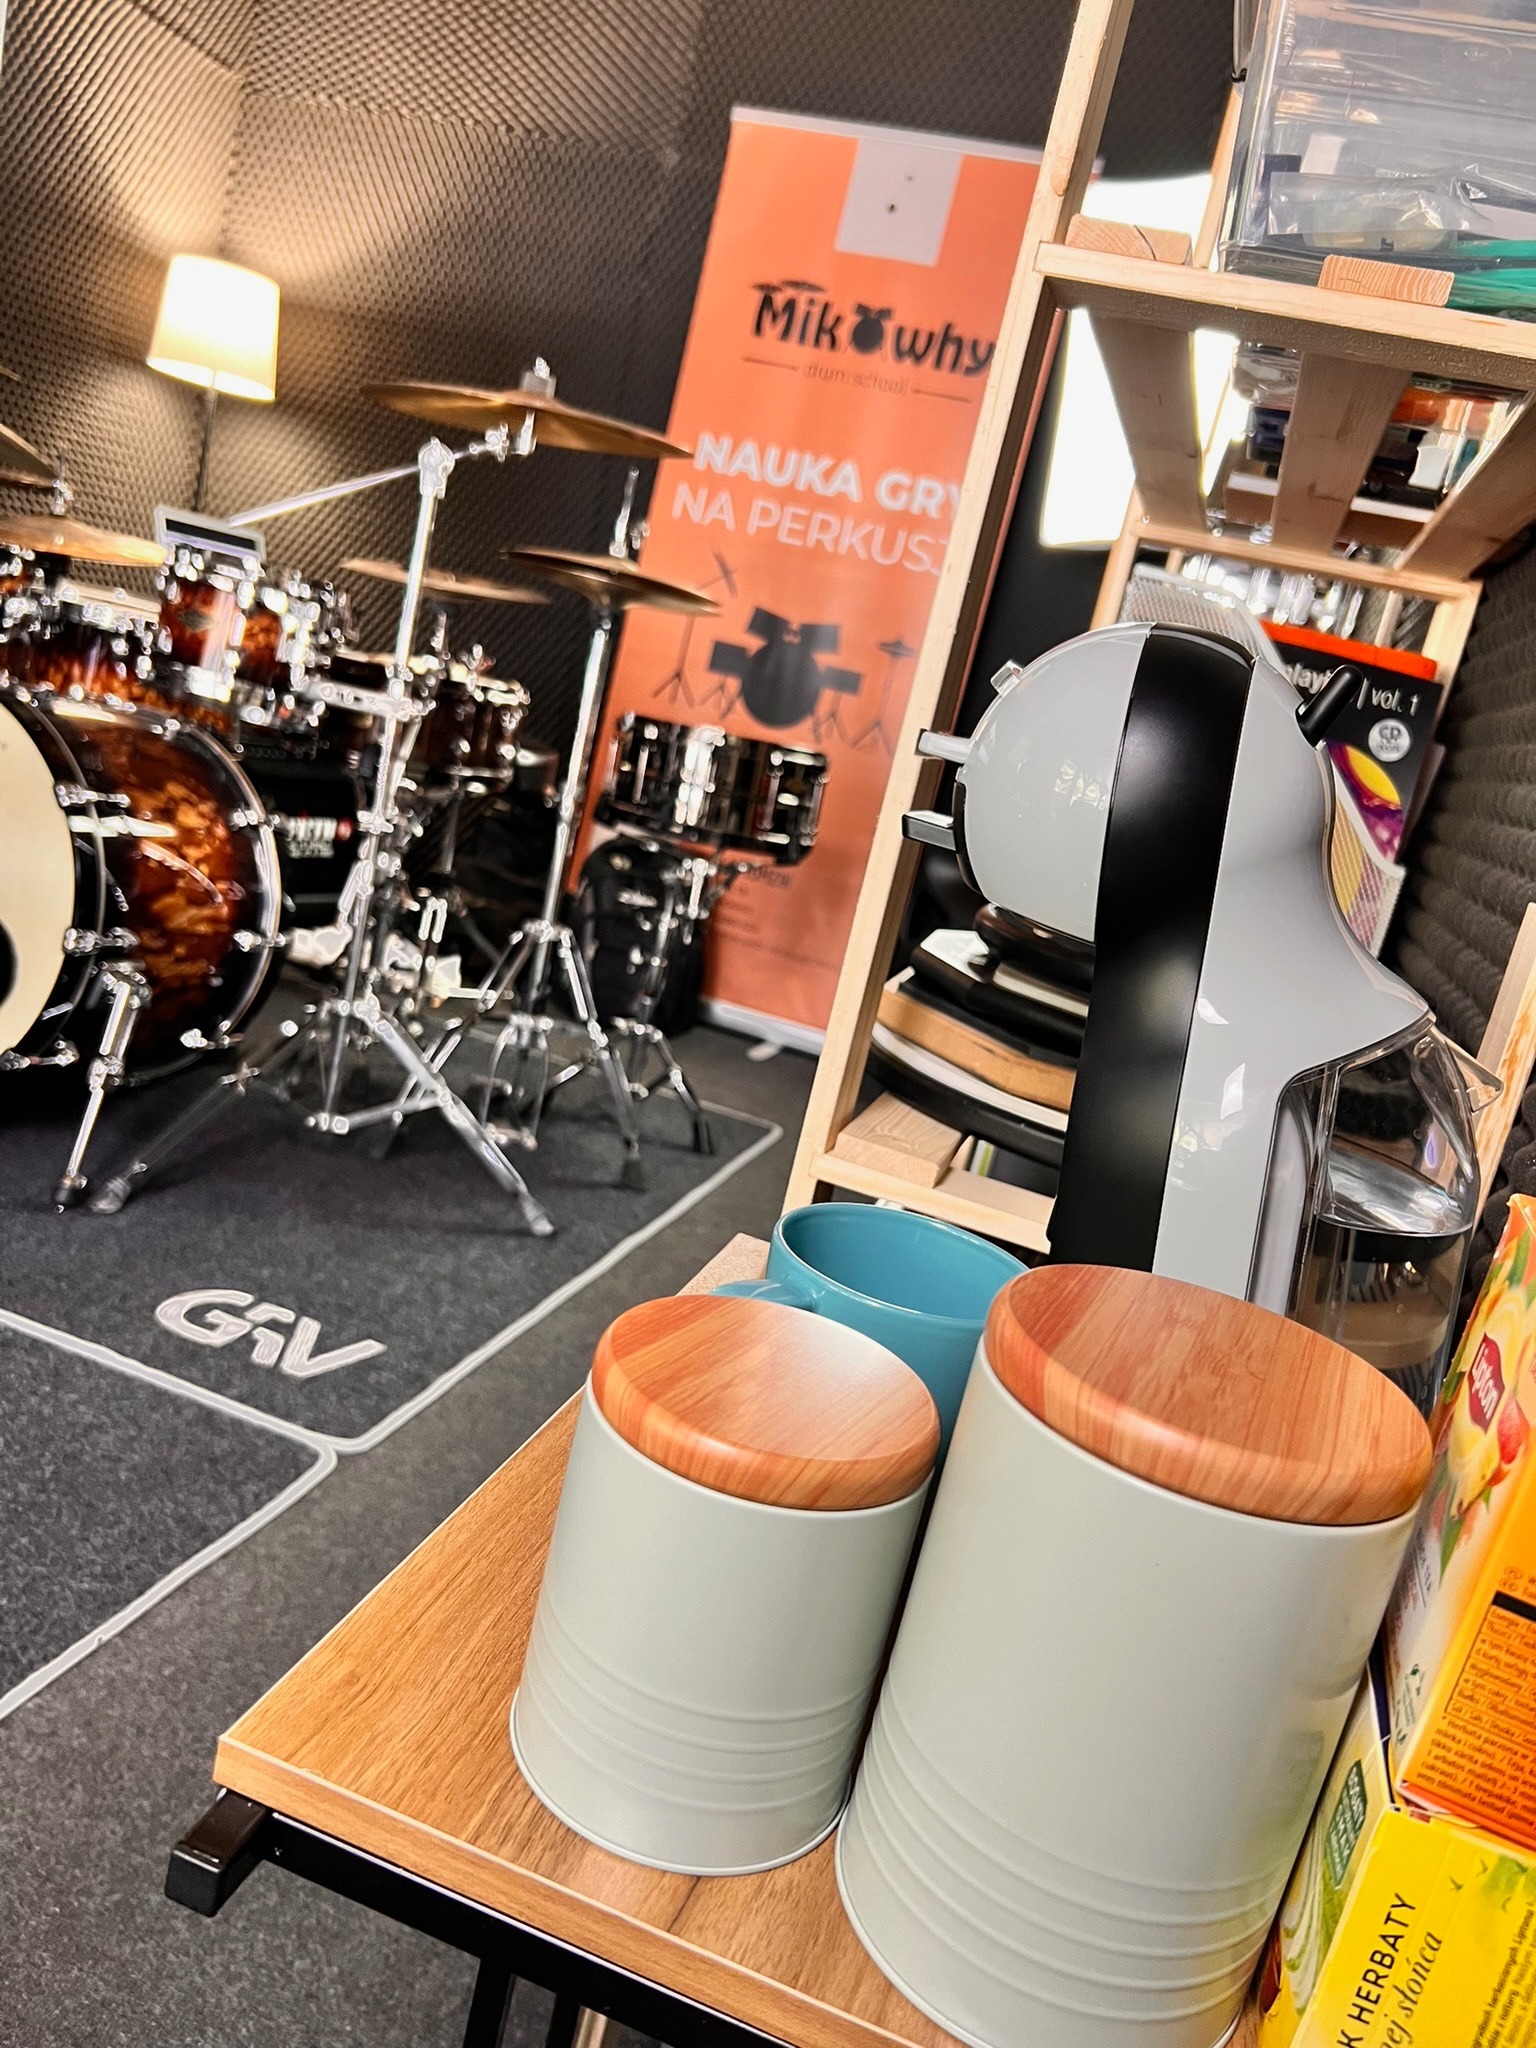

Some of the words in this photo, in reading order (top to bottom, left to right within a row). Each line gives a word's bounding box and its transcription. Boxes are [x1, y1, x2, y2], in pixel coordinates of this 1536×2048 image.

[694, 433, 861, 503] NAUKA
[672, 482, 736, 531] NA
[1372, 687, 1403, 712] vol.
[1410, 694, 1420, 716] 1
[1379, 724, 1401, 741] CD
[1472, 1343, 1500, 1420] Lipton
[1347, 1893, 1417, 2026] HERBATY
[1392, 1931, 1443, 2019] słońca
